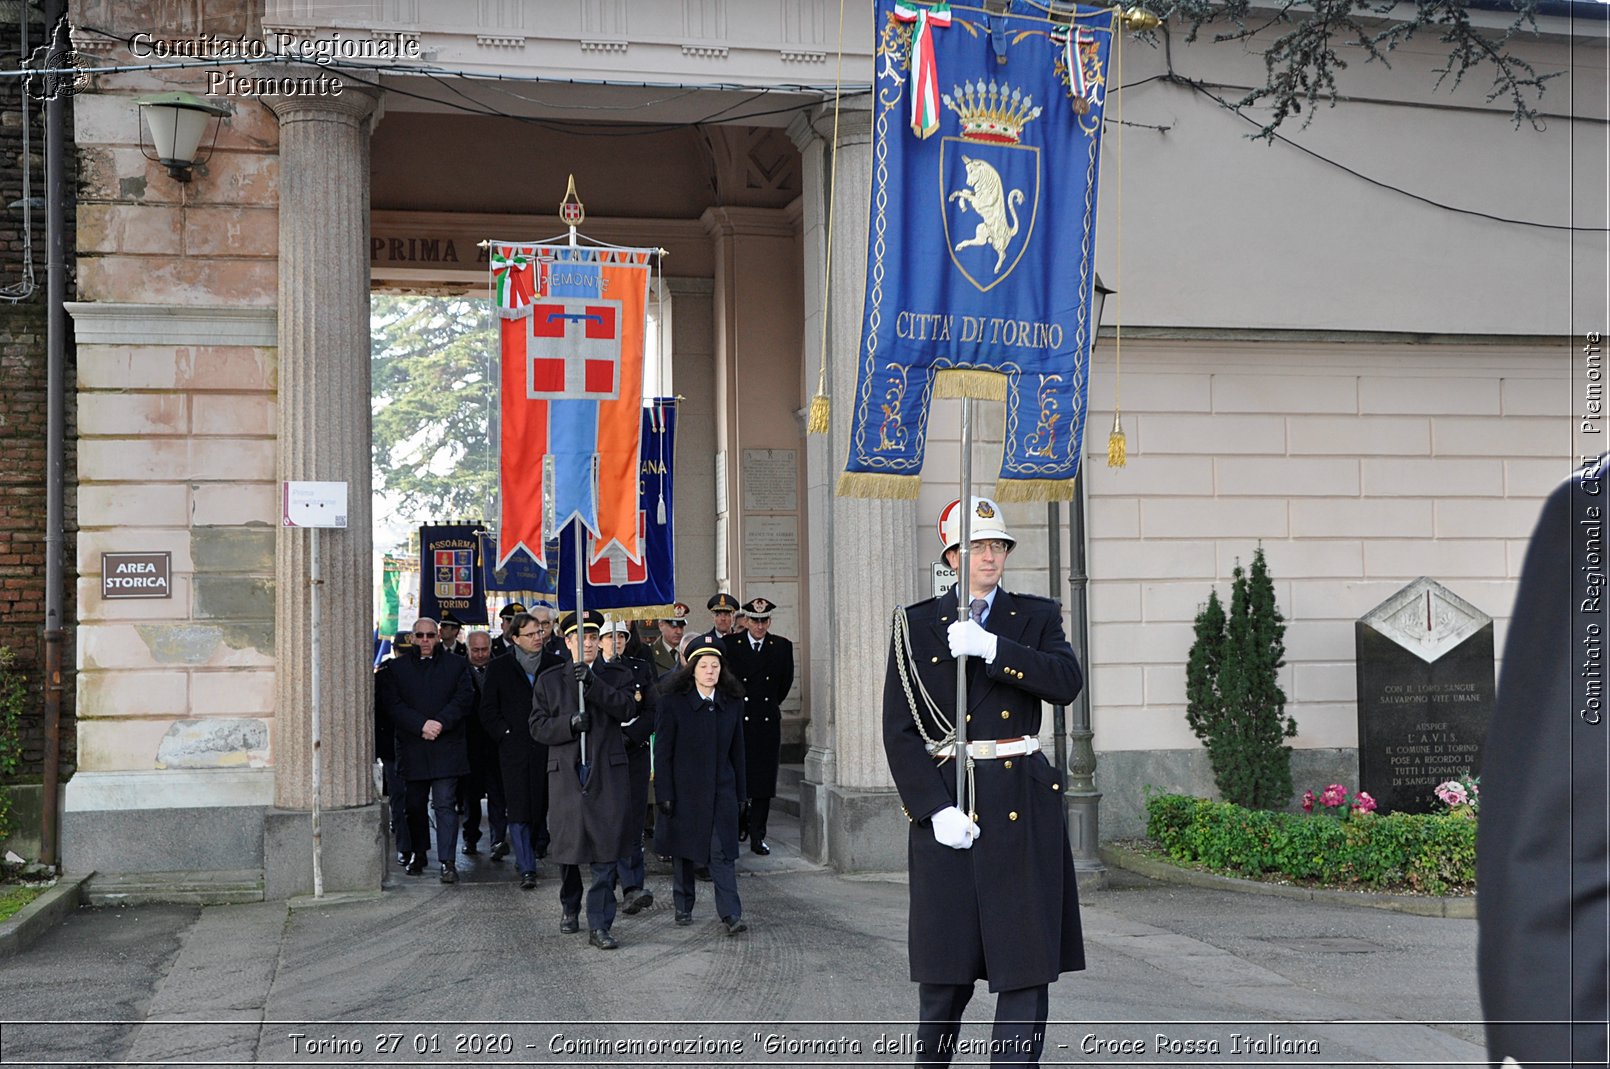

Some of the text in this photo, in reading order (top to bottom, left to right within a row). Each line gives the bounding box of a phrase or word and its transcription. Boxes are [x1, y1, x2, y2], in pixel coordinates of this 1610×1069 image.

[370, 237, 459, 262] PRIMA
[541, 272, 609, 292] PIEMONTE
[961, 316, 985, 343] DI
[990, 318, 1063, 350] TORINO
[429, 539, 477, 551] ASSOARMA
[116, 562, 156, 574] AREA
[106, 577, 167, 588] STORICA
[438, 600, 470, 609] TORINO
[1384, 685, 1402, 694] CON
[1444, 683, 1475, 692] SANGUE
[1453, 694, 1480, 702] UMANE
[1416, 723, 1447, 731] AUSPICE
[1386, 744, 1478, 754] IL COMUNE DI TORINO
[1391, 756, 1410, 765] POSE
[1424, 755, 1461, 764] RICORDO
[1465, 755, 1474, 763] DI
[1395, 767, 1418, 775] TUTTI
[1429, 765, 1470, 775] DONATORI
[1393, 778, 1401, 786] DI
[1405, 777, 1436, 786] SANGUE
